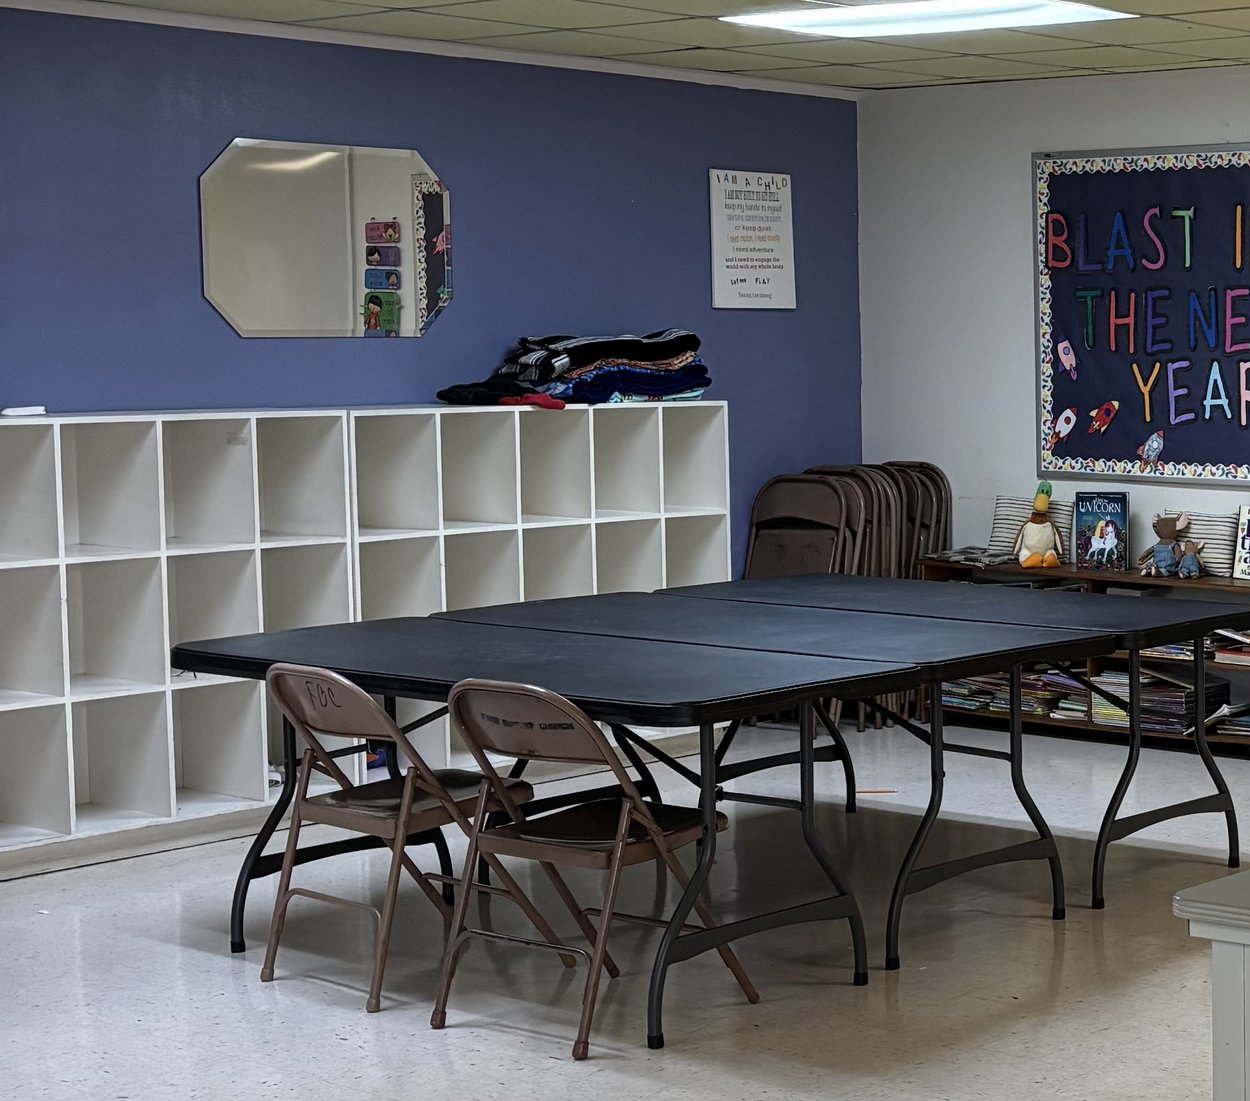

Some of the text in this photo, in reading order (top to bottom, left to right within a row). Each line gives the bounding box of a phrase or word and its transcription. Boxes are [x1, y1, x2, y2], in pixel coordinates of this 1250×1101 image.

[724, 173, 738, 185] AM
[745, 177, 751, 188] A
[757, 175, 788, 191] CHILD
[1046, 206, 1195, 272] BLAST
[1075, 288, 1171, 354] THE
[1079, 500, 1121, 513] UNICORN
